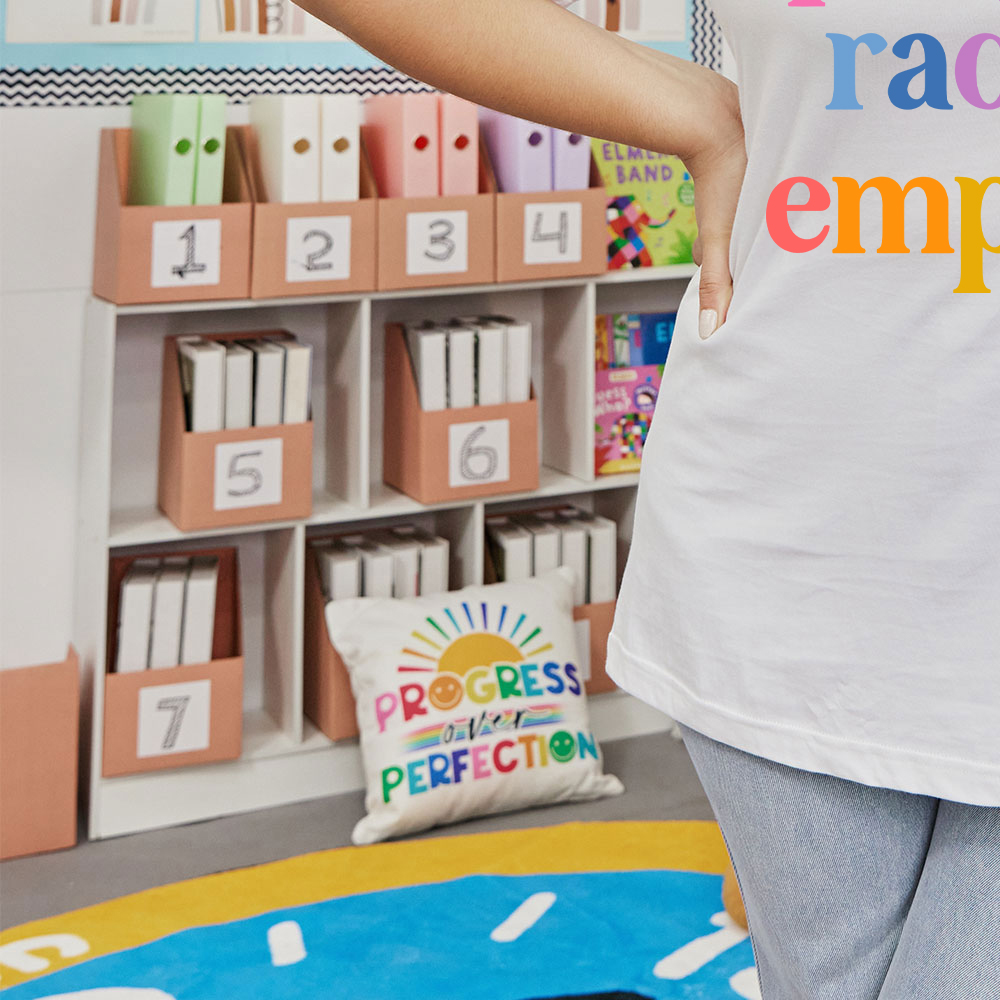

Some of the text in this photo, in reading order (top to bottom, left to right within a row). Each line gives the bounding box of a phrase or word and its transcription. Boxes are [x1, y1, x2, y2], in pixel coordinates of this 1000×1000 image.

[616, 165, 674, 185] BAND
[172, 224, 207, 280] 1
[302, 229, 334, 271] 2
[424, 219, 456, 263] 3
[531, 211, 568, 255] 4
[227, 449, 264, 498] 5
[459, 425, 497, 482] 6
[374, 662, 582, 733] PROGRESS
[156, 695, 191, 750] 7
[443, 708, 530, 744] over
[381, 730, 599, 804] PERFECTION
